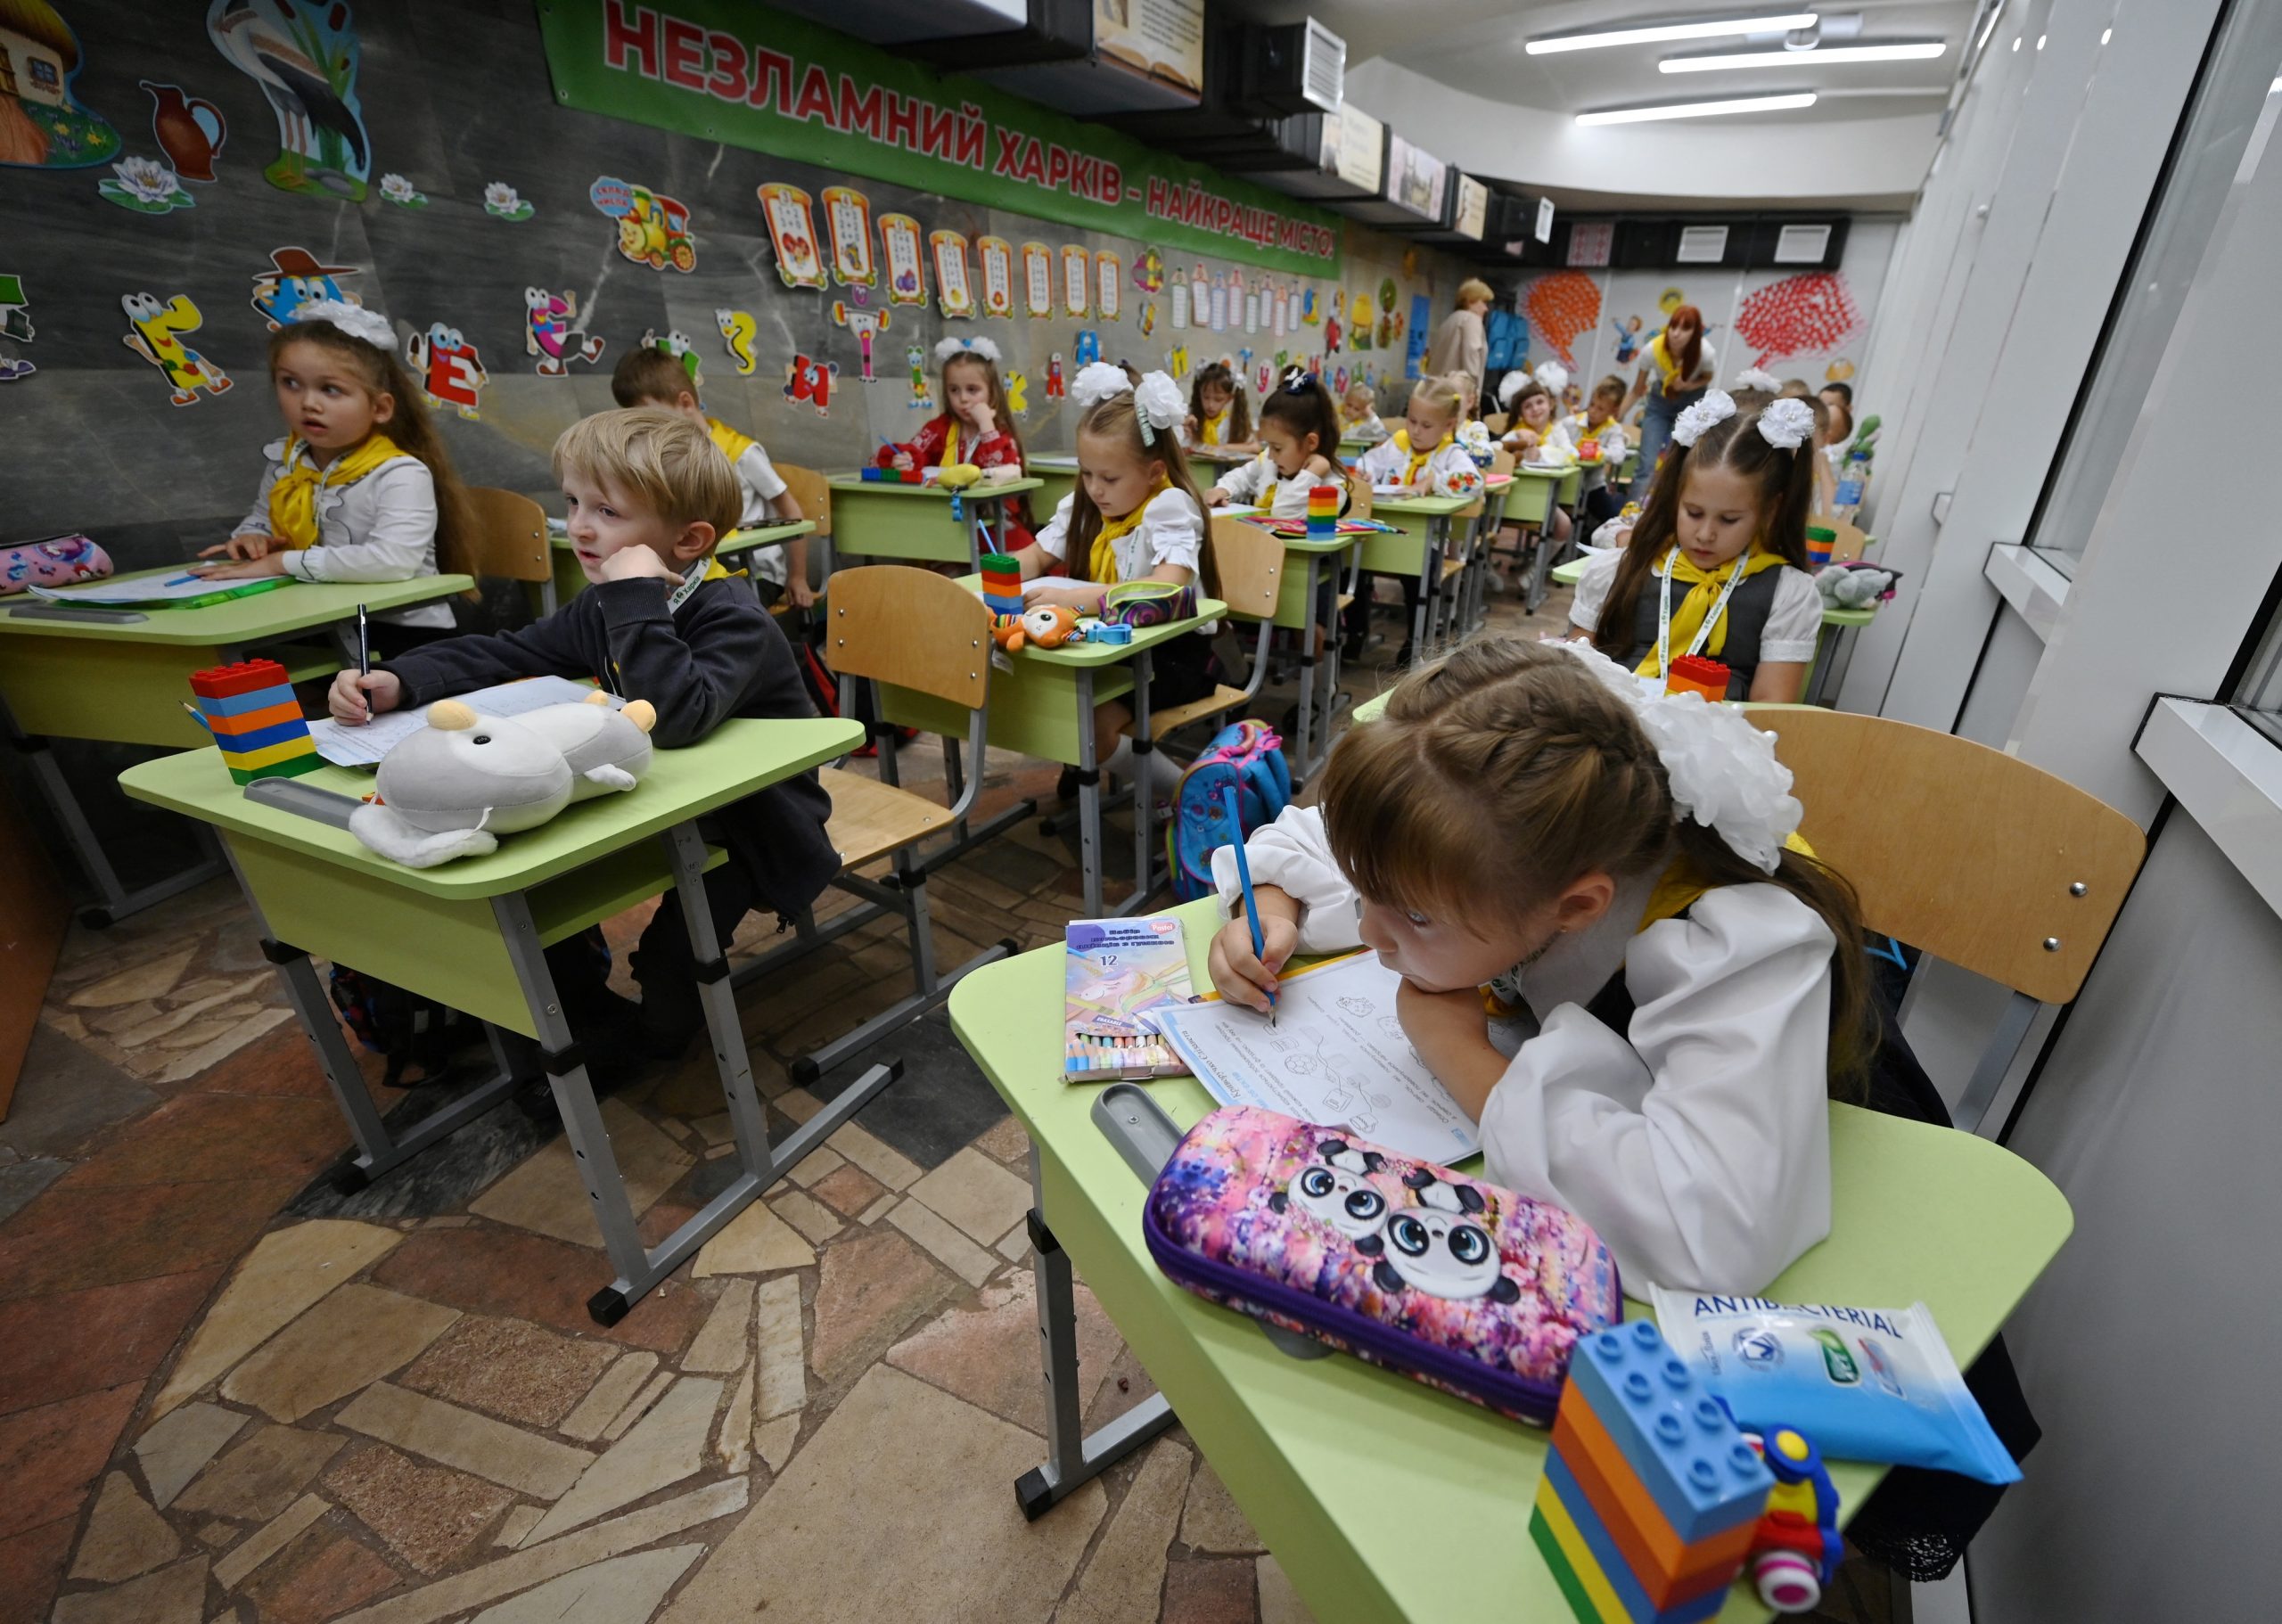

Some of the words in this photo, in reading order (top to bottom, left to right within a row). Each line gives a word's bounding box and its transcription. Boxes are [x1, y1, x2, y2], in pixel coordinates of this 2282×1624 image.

[604, 0, 987, 169] НЕЗЛАМНИЙ
[994, 127, 1122, 205] ХАРКІВ
[1146, 176, 1277, 250] НАЙКРАЩЕ
[1278, 217, 1335, 259] МІСТО!
[683, 575, 701, 595] Харків
[1152, 921, 1173, 931] Pastel
[1100, 955, 1118, 966] 12
[1695, 1293, 1903, 1339] ANTIBCTERIAL
